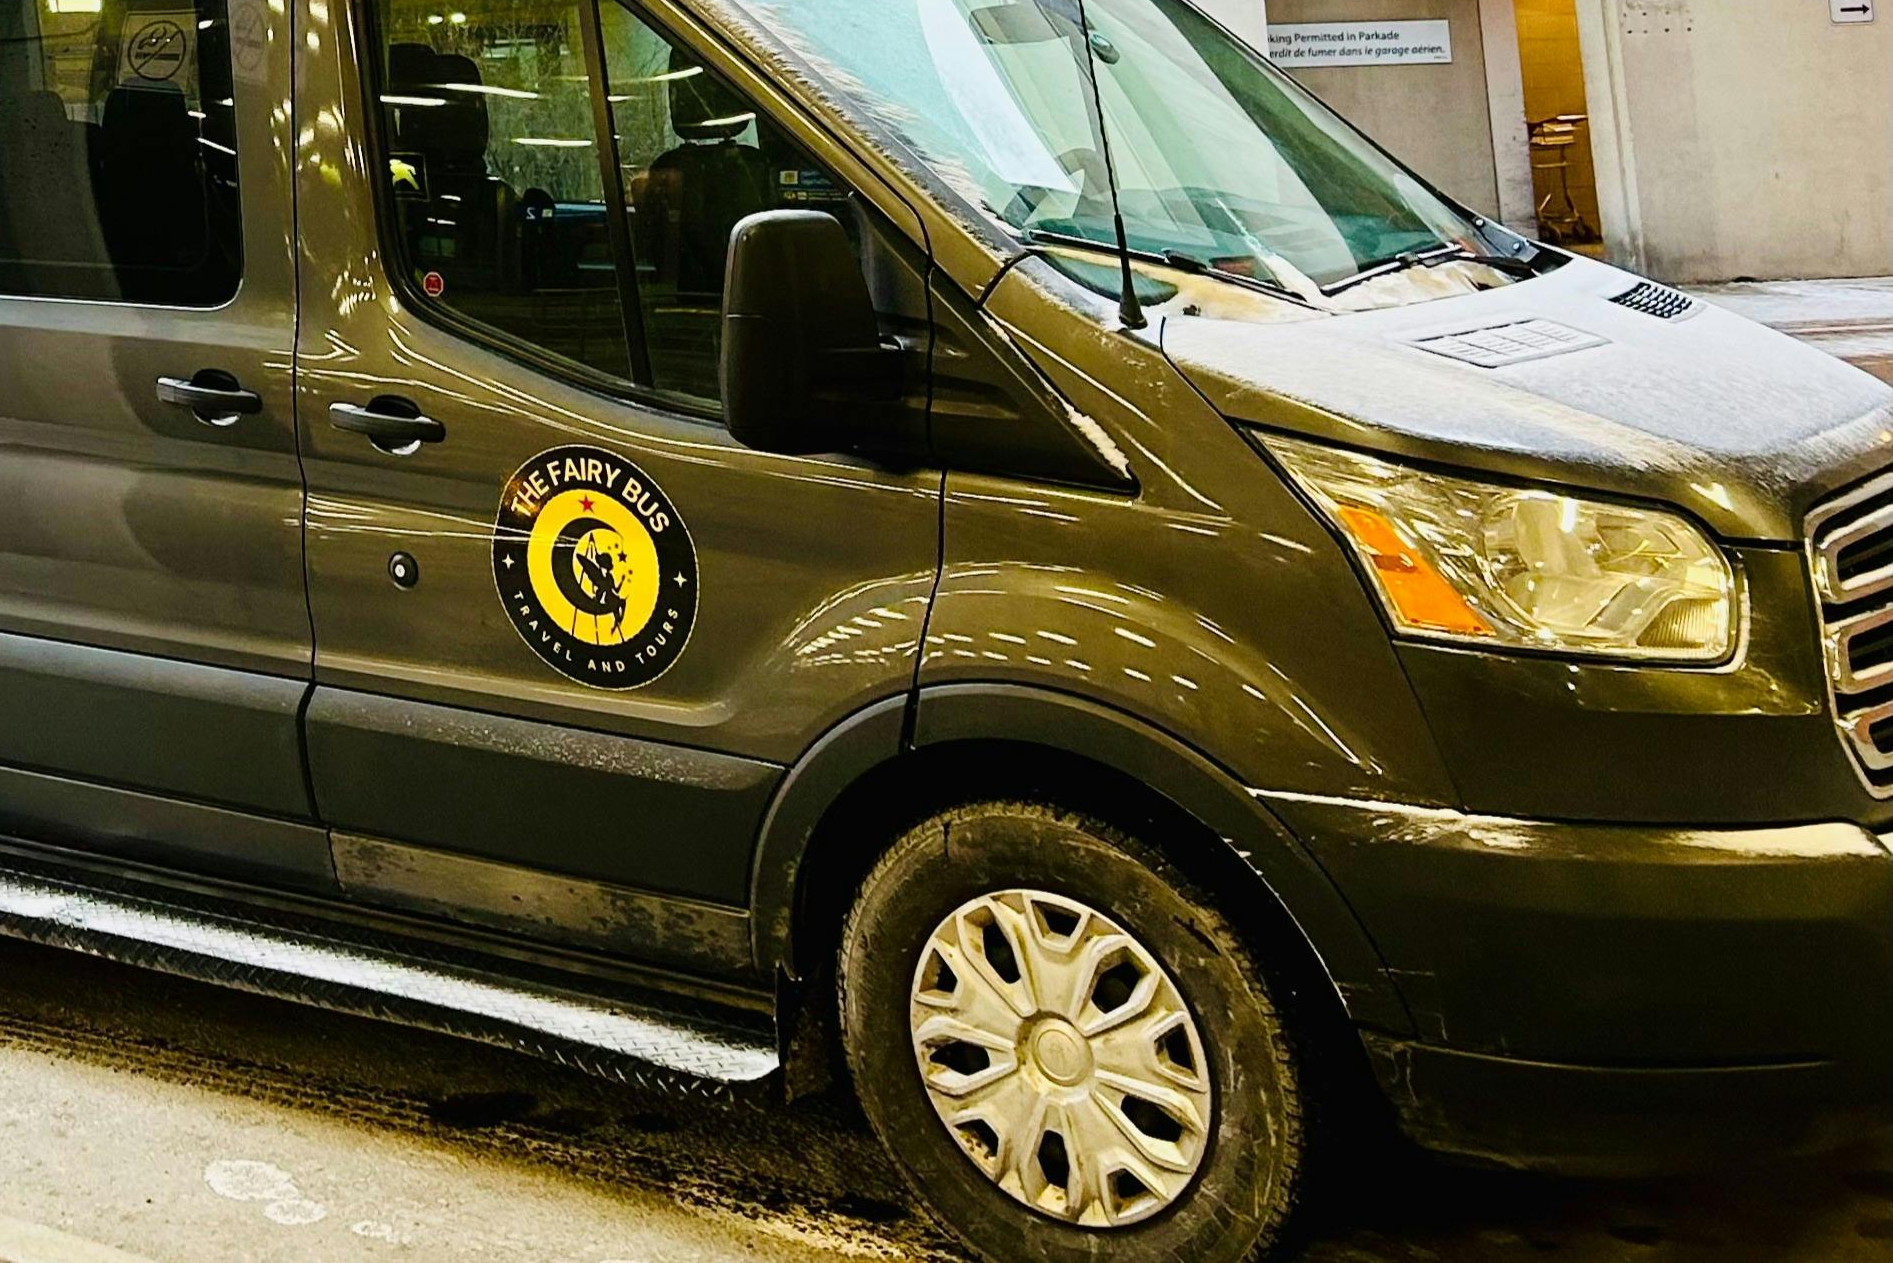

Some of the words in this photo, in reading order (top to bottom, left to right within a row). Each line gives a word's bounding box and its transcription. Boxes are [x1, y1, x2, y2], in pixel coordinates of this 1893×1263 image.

[1293, 46, 1306, 58] de
[1307, 46, 1337, 58] fumer
[1338, 46, 1363, 57] dans
[1364, 45, 1374, 55] le
[1375, 46, 1410, 58] garage
[1294, 31, 1345, 43] Permitted
[1346, 31, 1357, 42] in
[1358, 30, 1400, 41] Parkade
[510, 470, 550, 517] THE
[546, 457, 622, 489] FAIRY
[621, 477, 670, 533] BUS
[513, 590, 573, 662] TRAVEL
[587, 658, 626, 673] AND
[634, 607, 680, 665] TOURS
